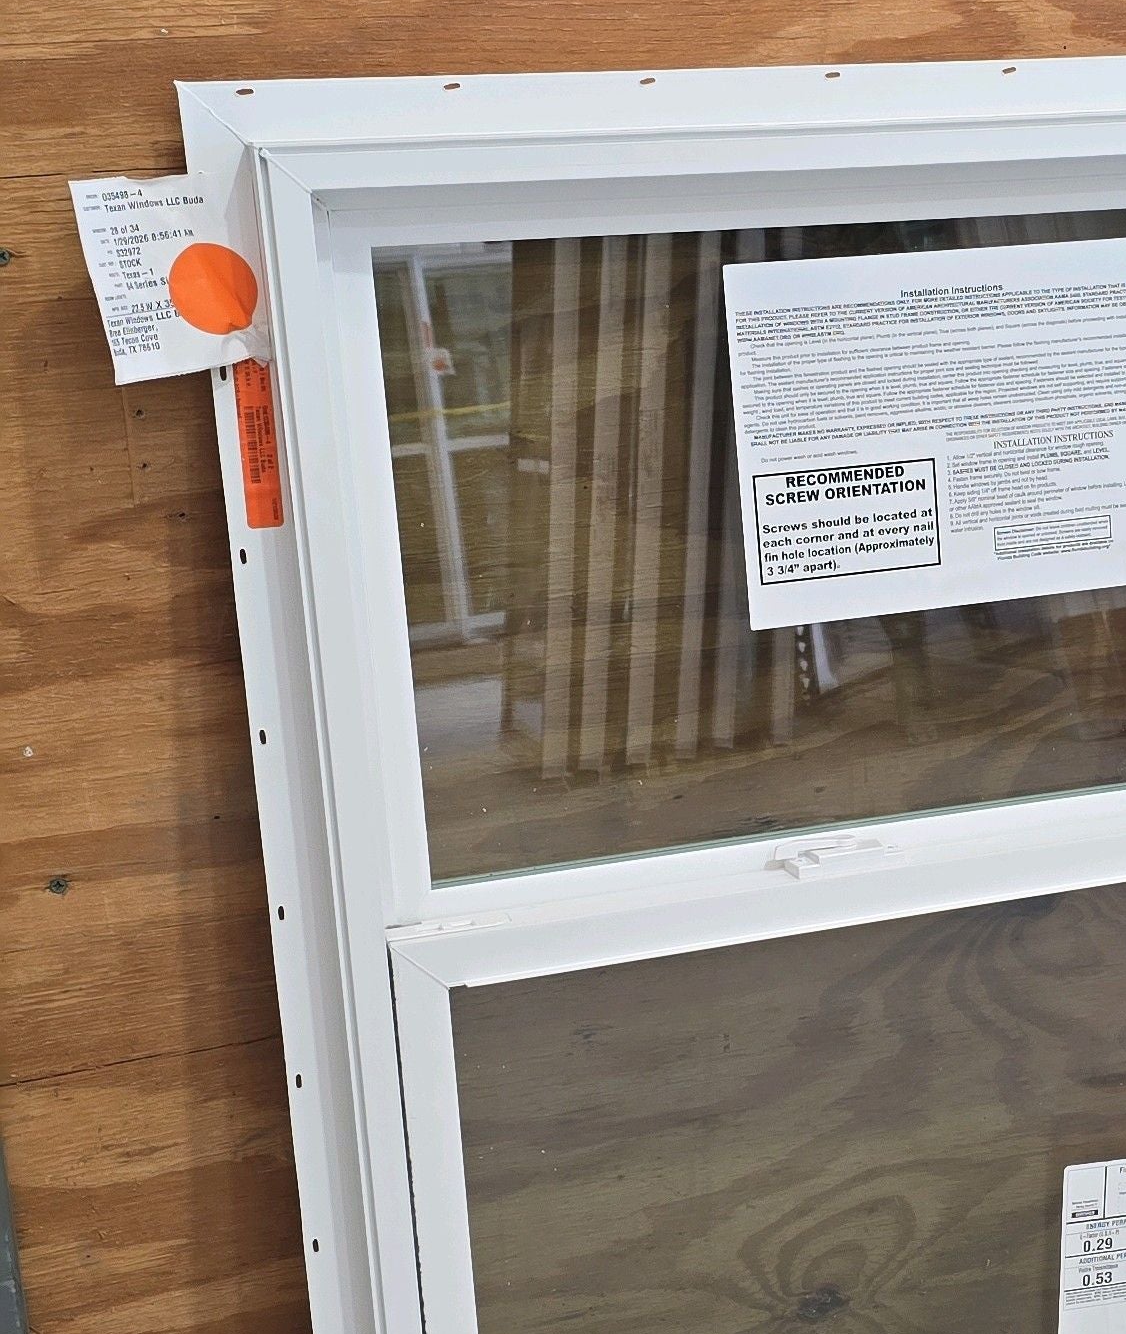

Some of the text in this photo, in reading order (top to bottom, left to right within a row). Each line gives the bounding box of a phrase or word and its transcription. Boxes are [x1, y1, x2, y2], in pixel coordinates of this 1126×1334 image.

[104, 203, 126, 213] Texan
[128, 198, 163, 210] Windows
[165, 196, 181, 206] LLC
[182, 195, 204, 205] Buda
[120, 225, 127, 234] of
[129, 224, 140, 232] 34
[119, 258, 142, 269] STOCK
[900, 285, 1004, 298] Installation Instructions
[155, 301, 162, 309] X
[107, 318, 124, 328] Texan
[125, 314, 154, 325] Windows
[155, 311, 172, 320] LLC
[128, 345, 137, 354] TX
[993, 430, 1114, 449] INSTALLATION INSTRUCTIONS
[786, 465, 905, 488] RECOMMENDED
[765, 479, 926, 506] SCREW ORIENTATION
[763, 509, 933, 534] Screws should be located at
[763, 523, 934, 548] each corner and at every nail
[764, 537, 935, 562] fin hole location (Approximately
[767, 561, 841, 576] 3 3/4" apart).
[1086, 1221, 1109, 1230] ENERGY
[1084, 1238, 1112, 1252] 0.29
[1079, 1254, 1114, 1264] ADDITIONAL
[1082, 1271, 1113, 1287] 0.53
